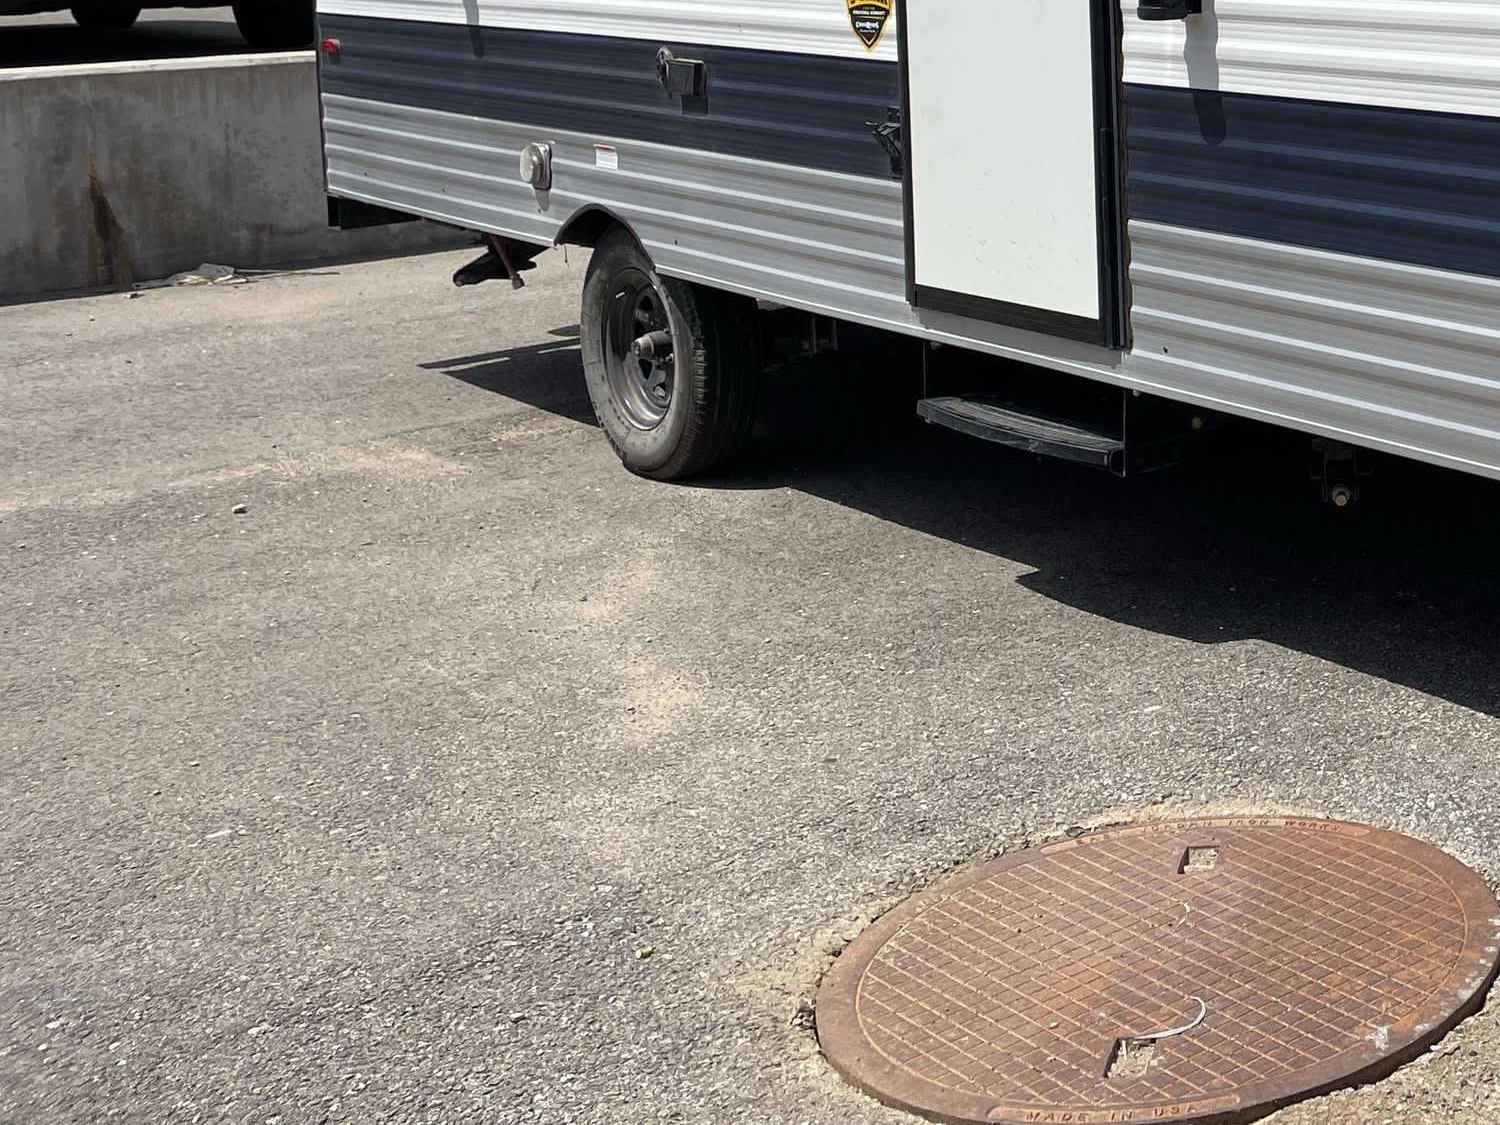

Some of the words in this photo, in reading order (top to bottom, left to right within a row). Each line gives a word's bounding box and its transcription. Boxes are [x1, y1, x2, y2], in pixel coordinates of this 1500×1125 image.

[1228, 818, 1270, 826] IRON
[1284, 819, 1340, 831] WORKS
[1026, 1111, 1090, 1123] MADE
[1110, 1111, 1133, 1122] IN
[1153, 1104, 1199, 1118] USA
